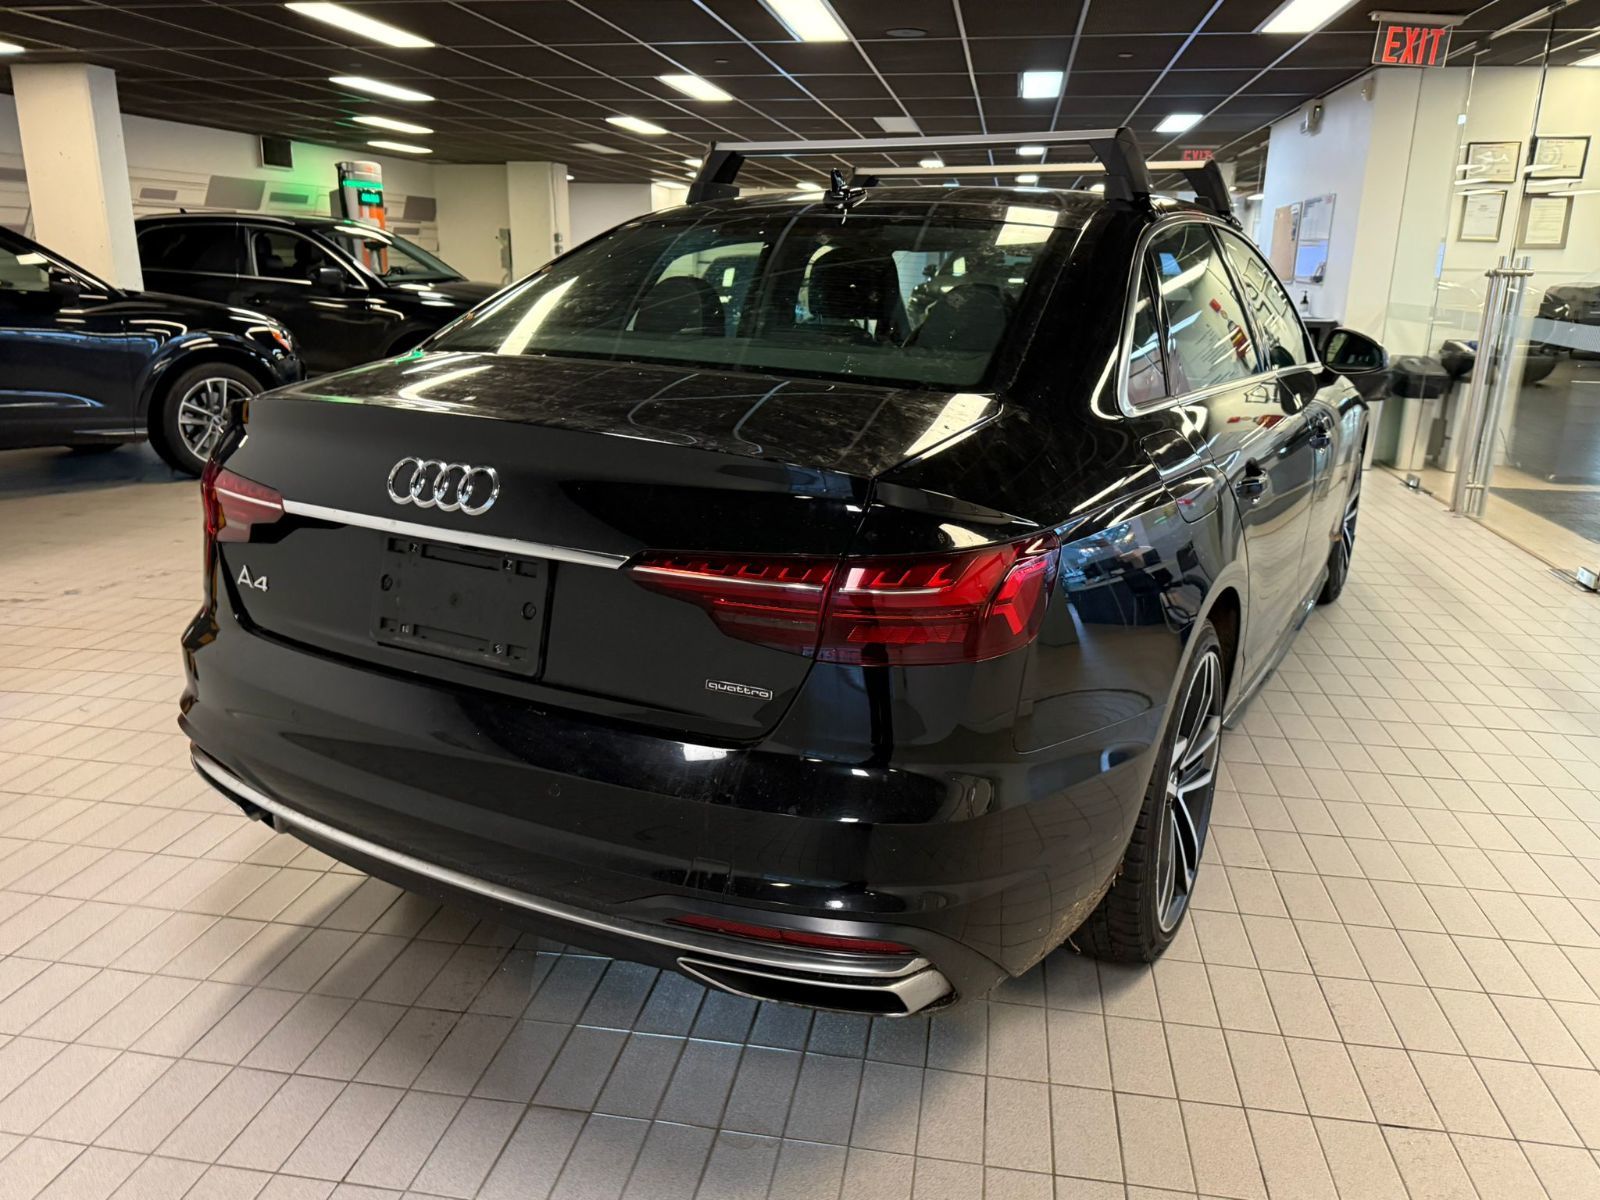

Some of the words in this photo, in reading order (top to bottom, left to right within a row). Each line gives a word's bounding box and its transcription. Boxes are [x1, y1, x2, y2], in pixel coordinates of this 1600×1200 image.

[1382, 26, 1445, 65] EXIT
[237, 564, 268, 592] A4
[708, 682, 770, 698] quattro
